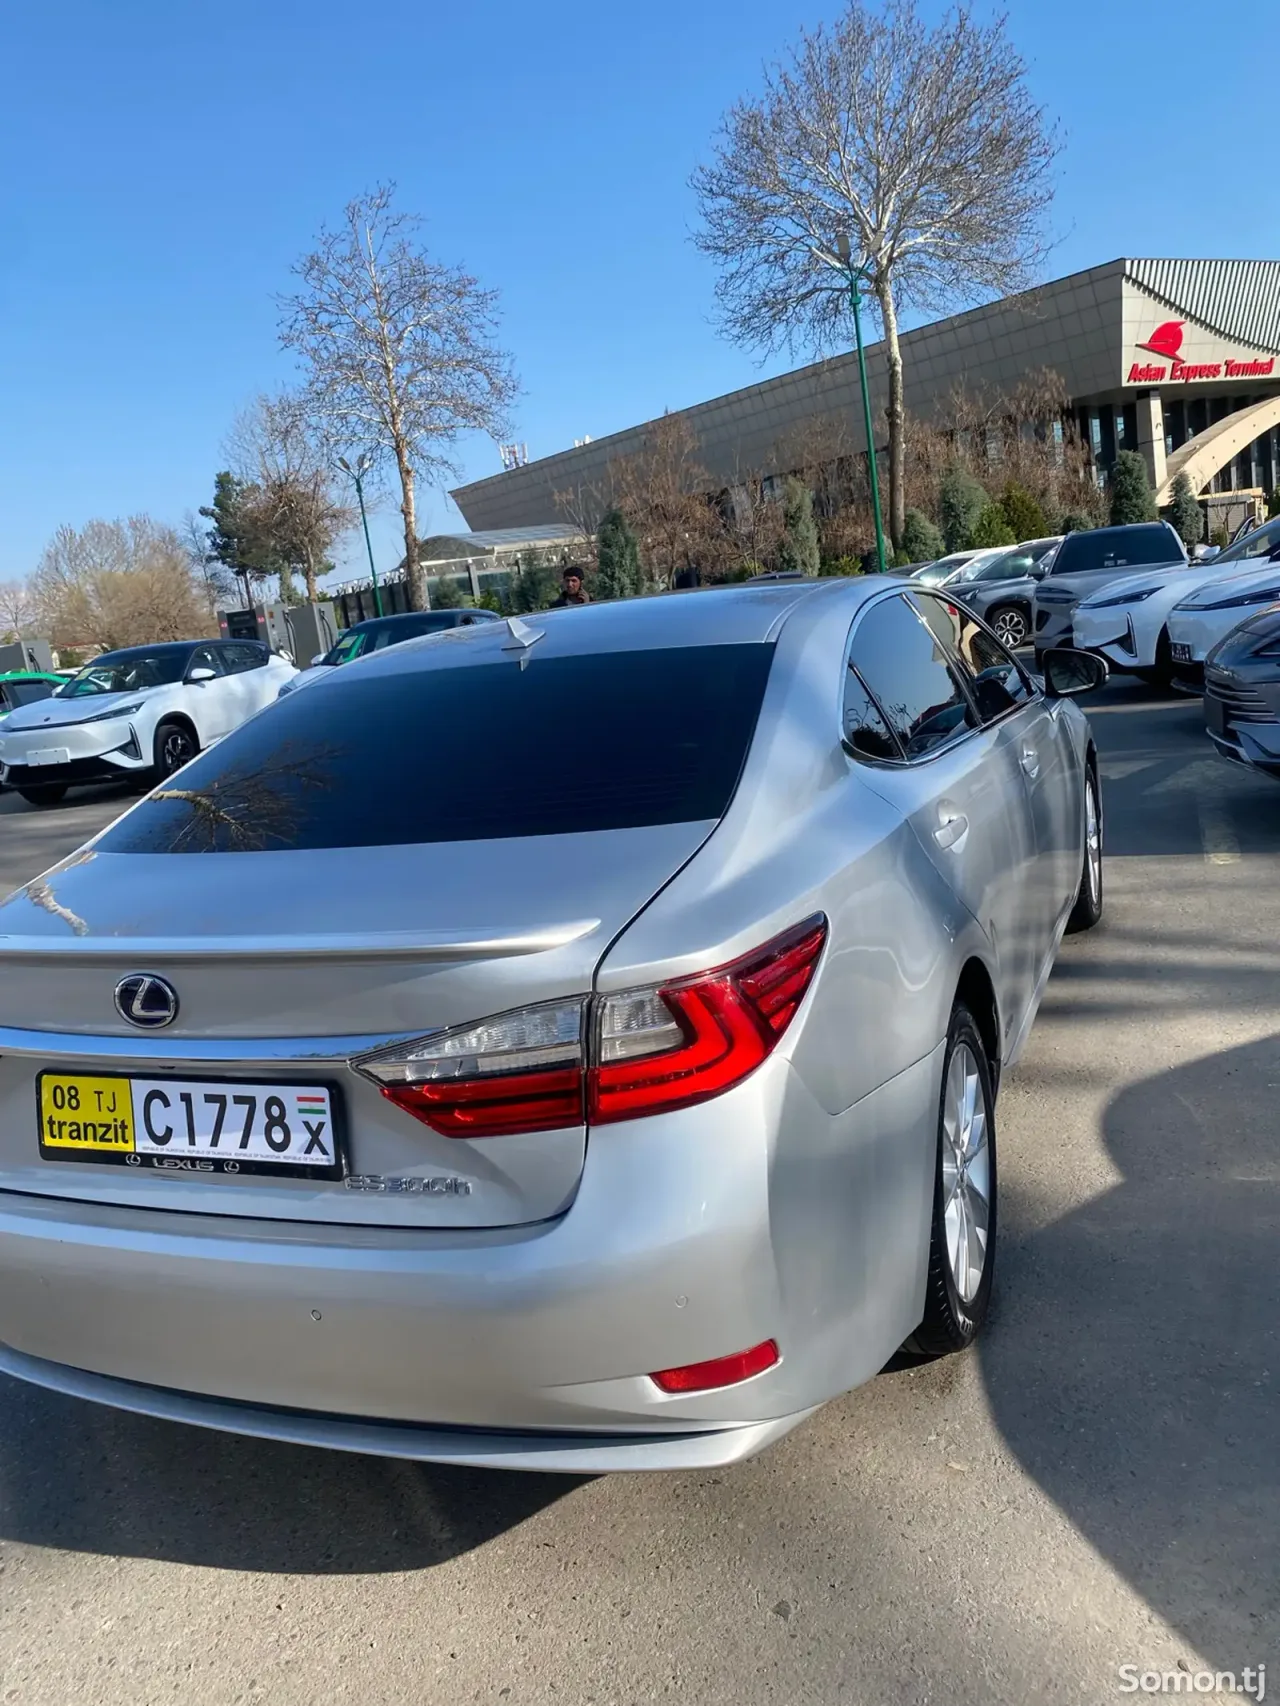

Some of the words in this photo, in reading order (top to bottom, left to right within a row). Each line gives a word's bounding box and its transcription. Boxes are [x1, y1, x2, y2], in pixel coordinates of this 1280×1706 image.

[1127, 363, 1166, 383] Asian
[1170, 362, 1221, 384] Express
[1224, 357, 1275, 378] Terminal
[52, 1084, 81, 1111] 08
[93, 1090, 117, 1113] TJ
[47, 1114, 129, 1144] tranzit
[143, 1089, 291, 1153] C1778
[302, 1120, 330, 1156] X
[152, 1157, 214, 1172] LEXUS
